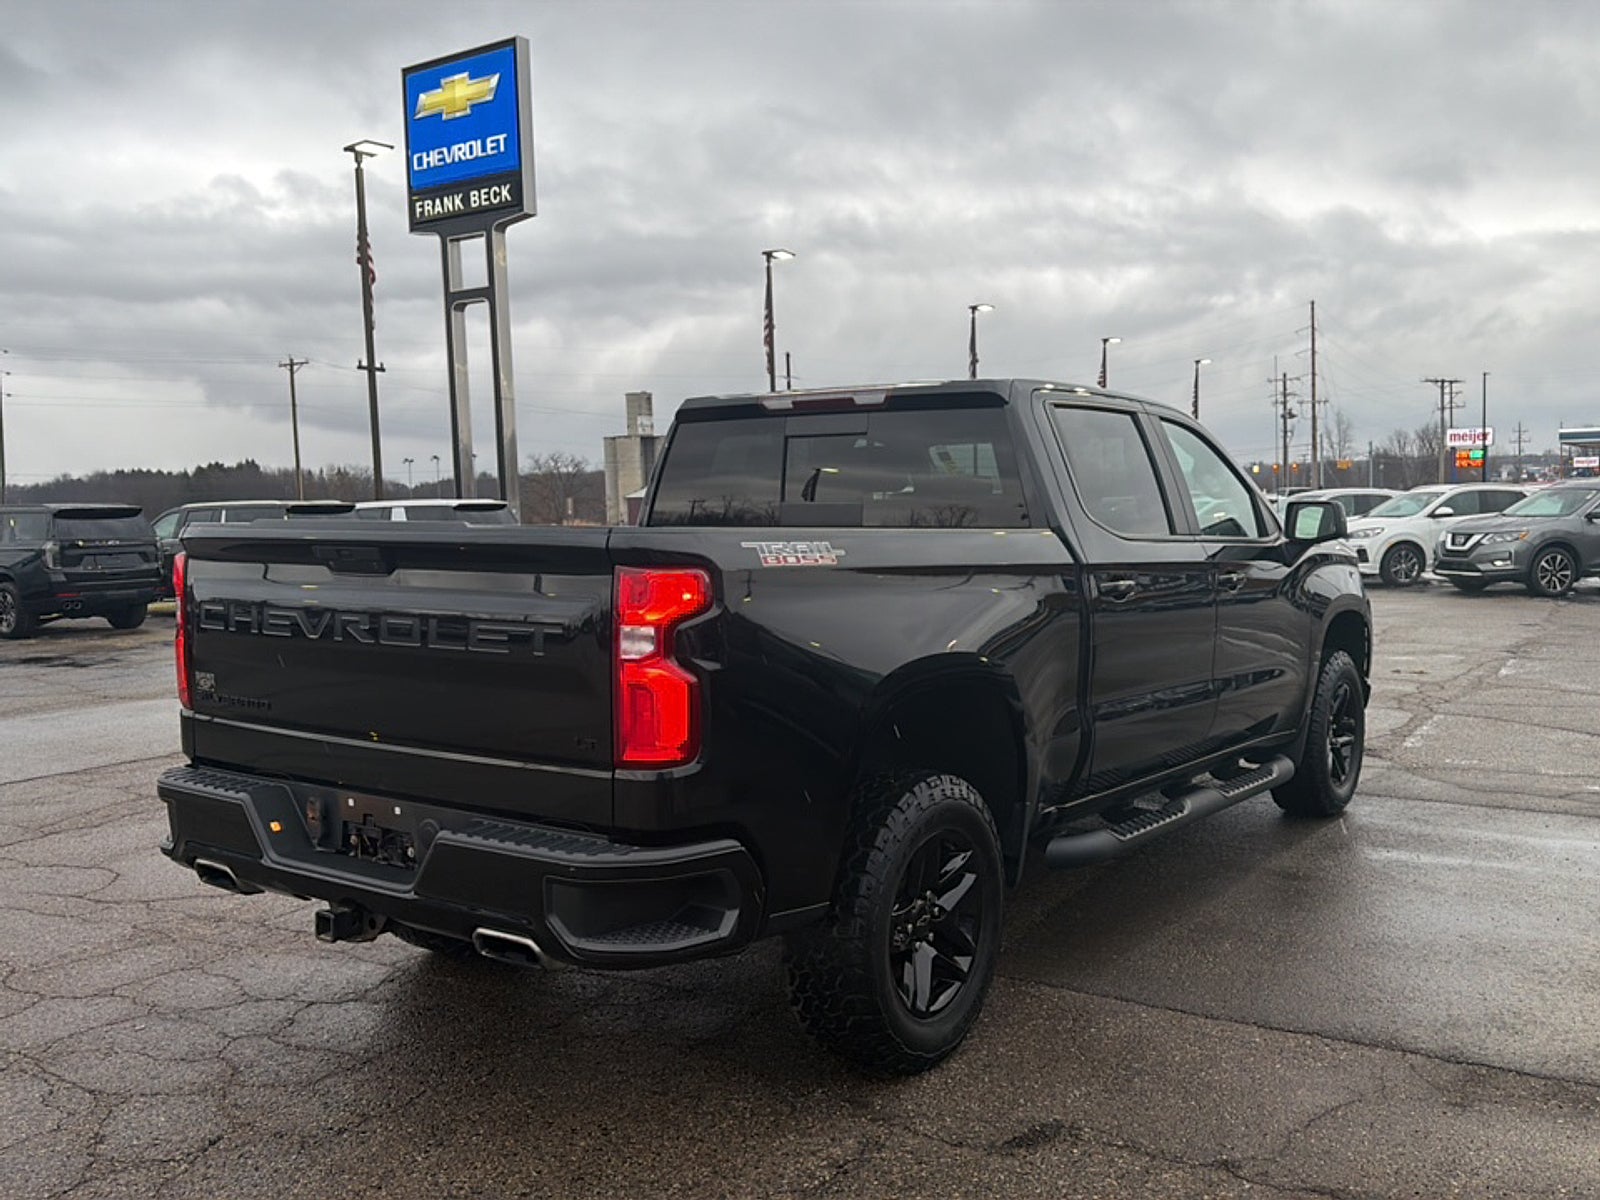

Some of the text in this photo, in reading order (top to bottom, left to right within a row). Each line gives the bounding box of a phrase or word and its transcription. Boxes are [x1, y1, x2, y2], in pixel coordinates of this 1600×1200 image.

[413, 133, 507, 171] CHEVROLET
[415, 183, 512, 219] FRANK BECK
[1449, 429, 1491, 444] meijer
[741, 541, 845, 556] TRAIL
[761, 554, 838, 567] BOSS
[200, 601, 564, 657] CHEVROLET
